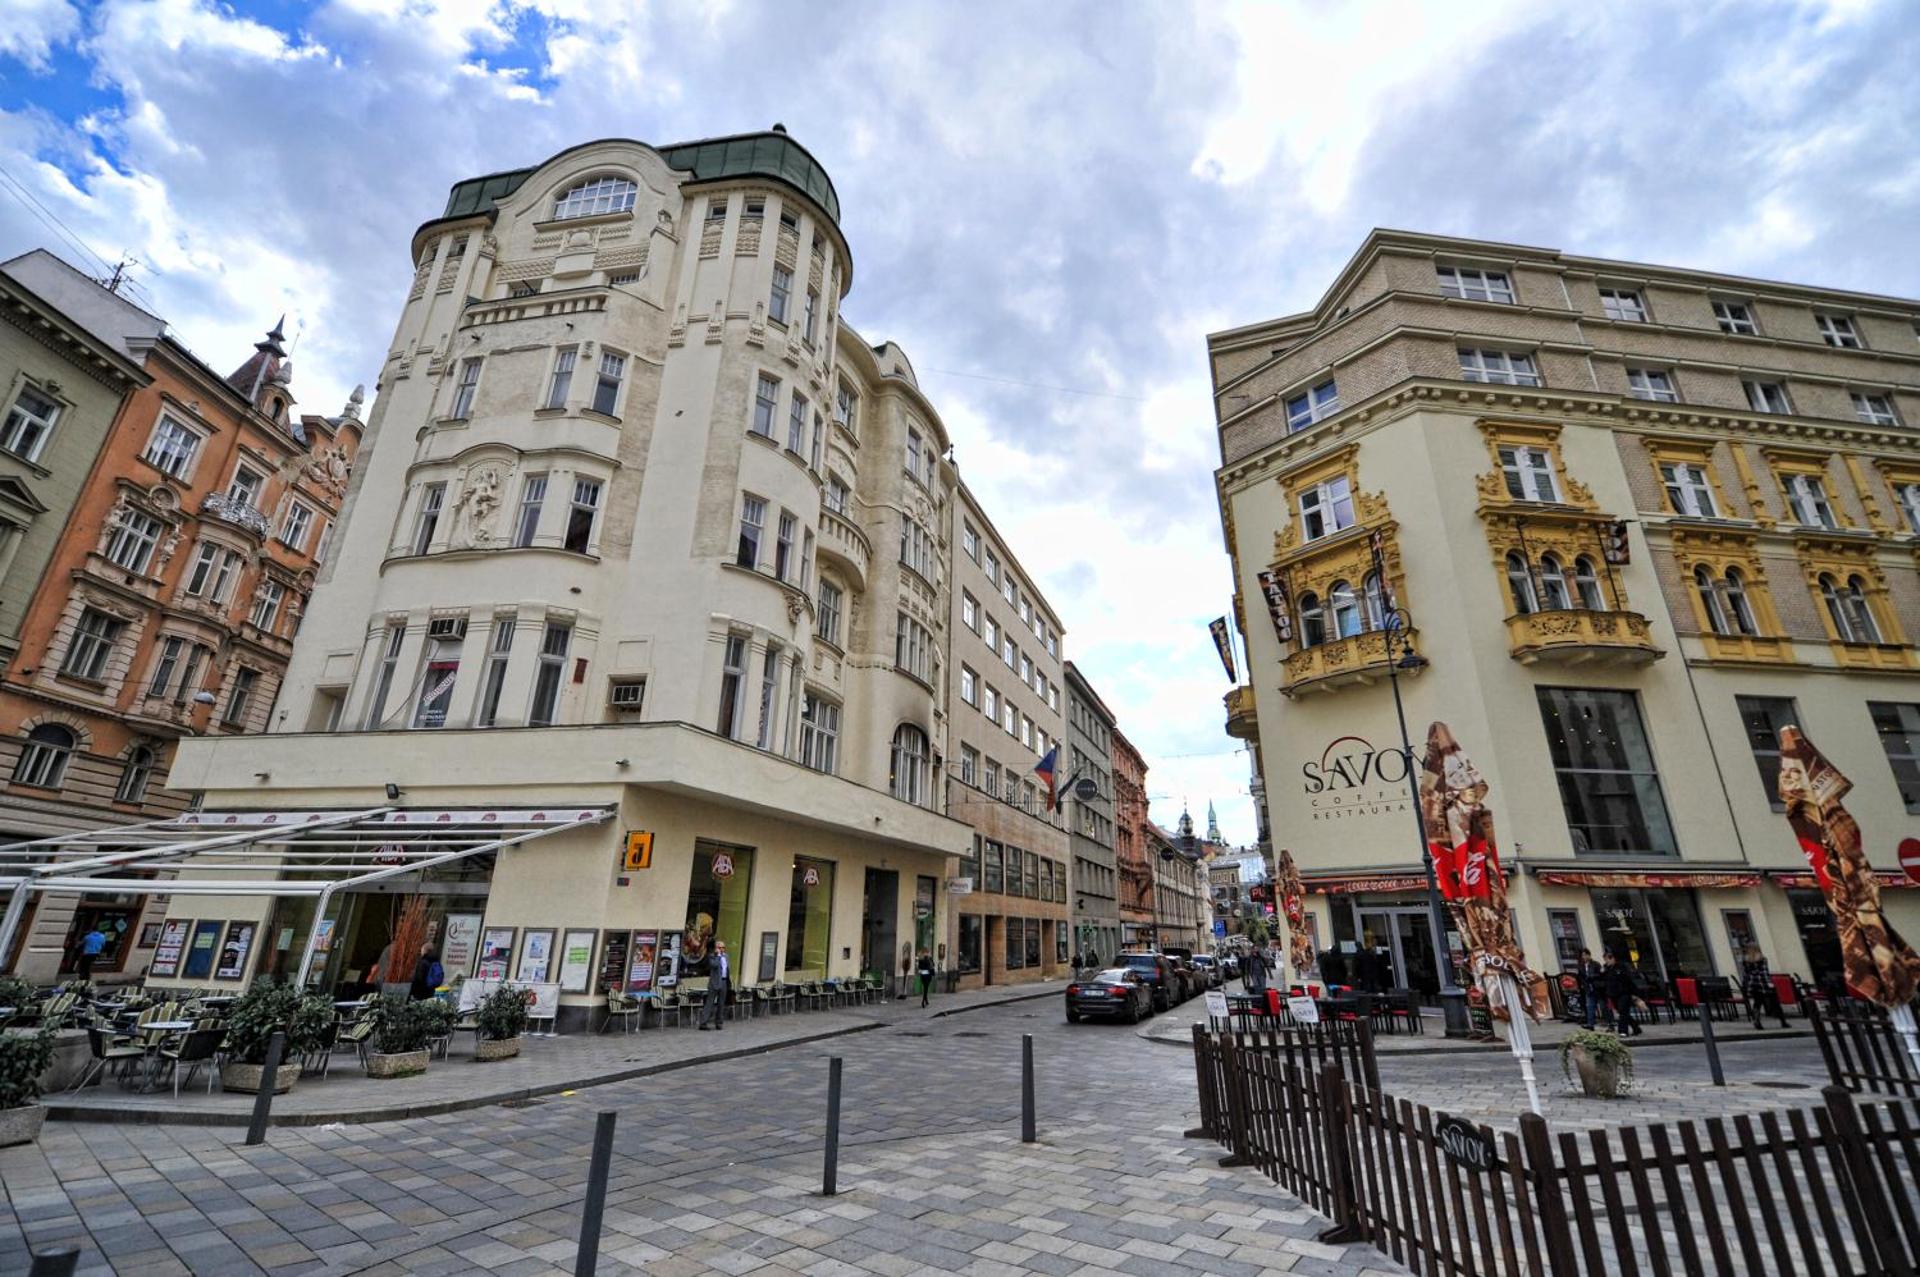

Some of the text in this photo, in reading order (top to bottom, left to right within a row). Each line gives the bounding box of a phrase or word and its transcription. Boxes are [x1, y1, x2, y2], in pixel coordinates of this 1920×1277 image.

[1262, 572, 1292, 640] TATTOO
[1313, 803, 1406, 820] RESTAURA
[1441, 1127, 1486, 1167] SAVOY
